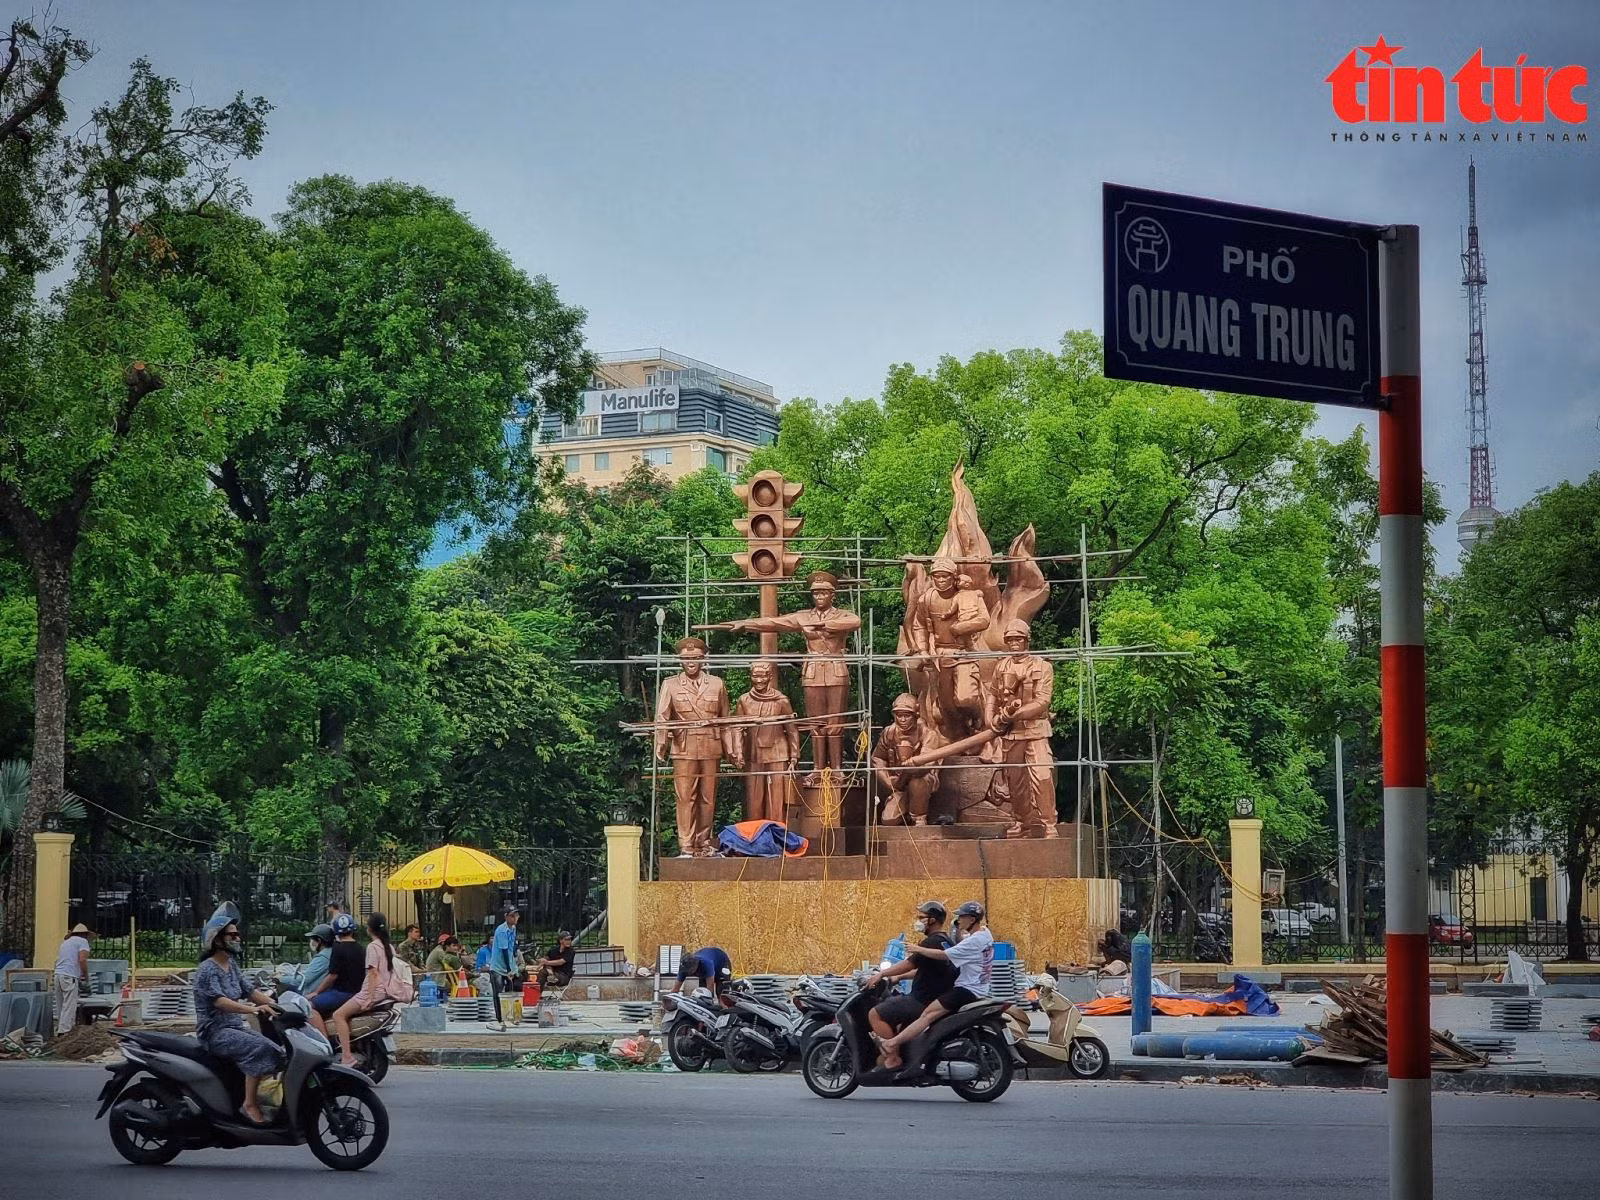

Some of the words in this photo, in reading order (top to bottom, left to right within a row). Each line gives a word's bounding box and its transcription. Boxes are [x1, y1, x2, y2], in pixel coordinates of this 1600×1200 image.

[1222, 246, 1299, 284] PHỐ
[1127, 284, 1241, 358] QUANG
[1251, 302, 1355, 371] TRUNG
[601, 387, 676, 411] Manulife
[412, 878, 433, 886] CSGT
